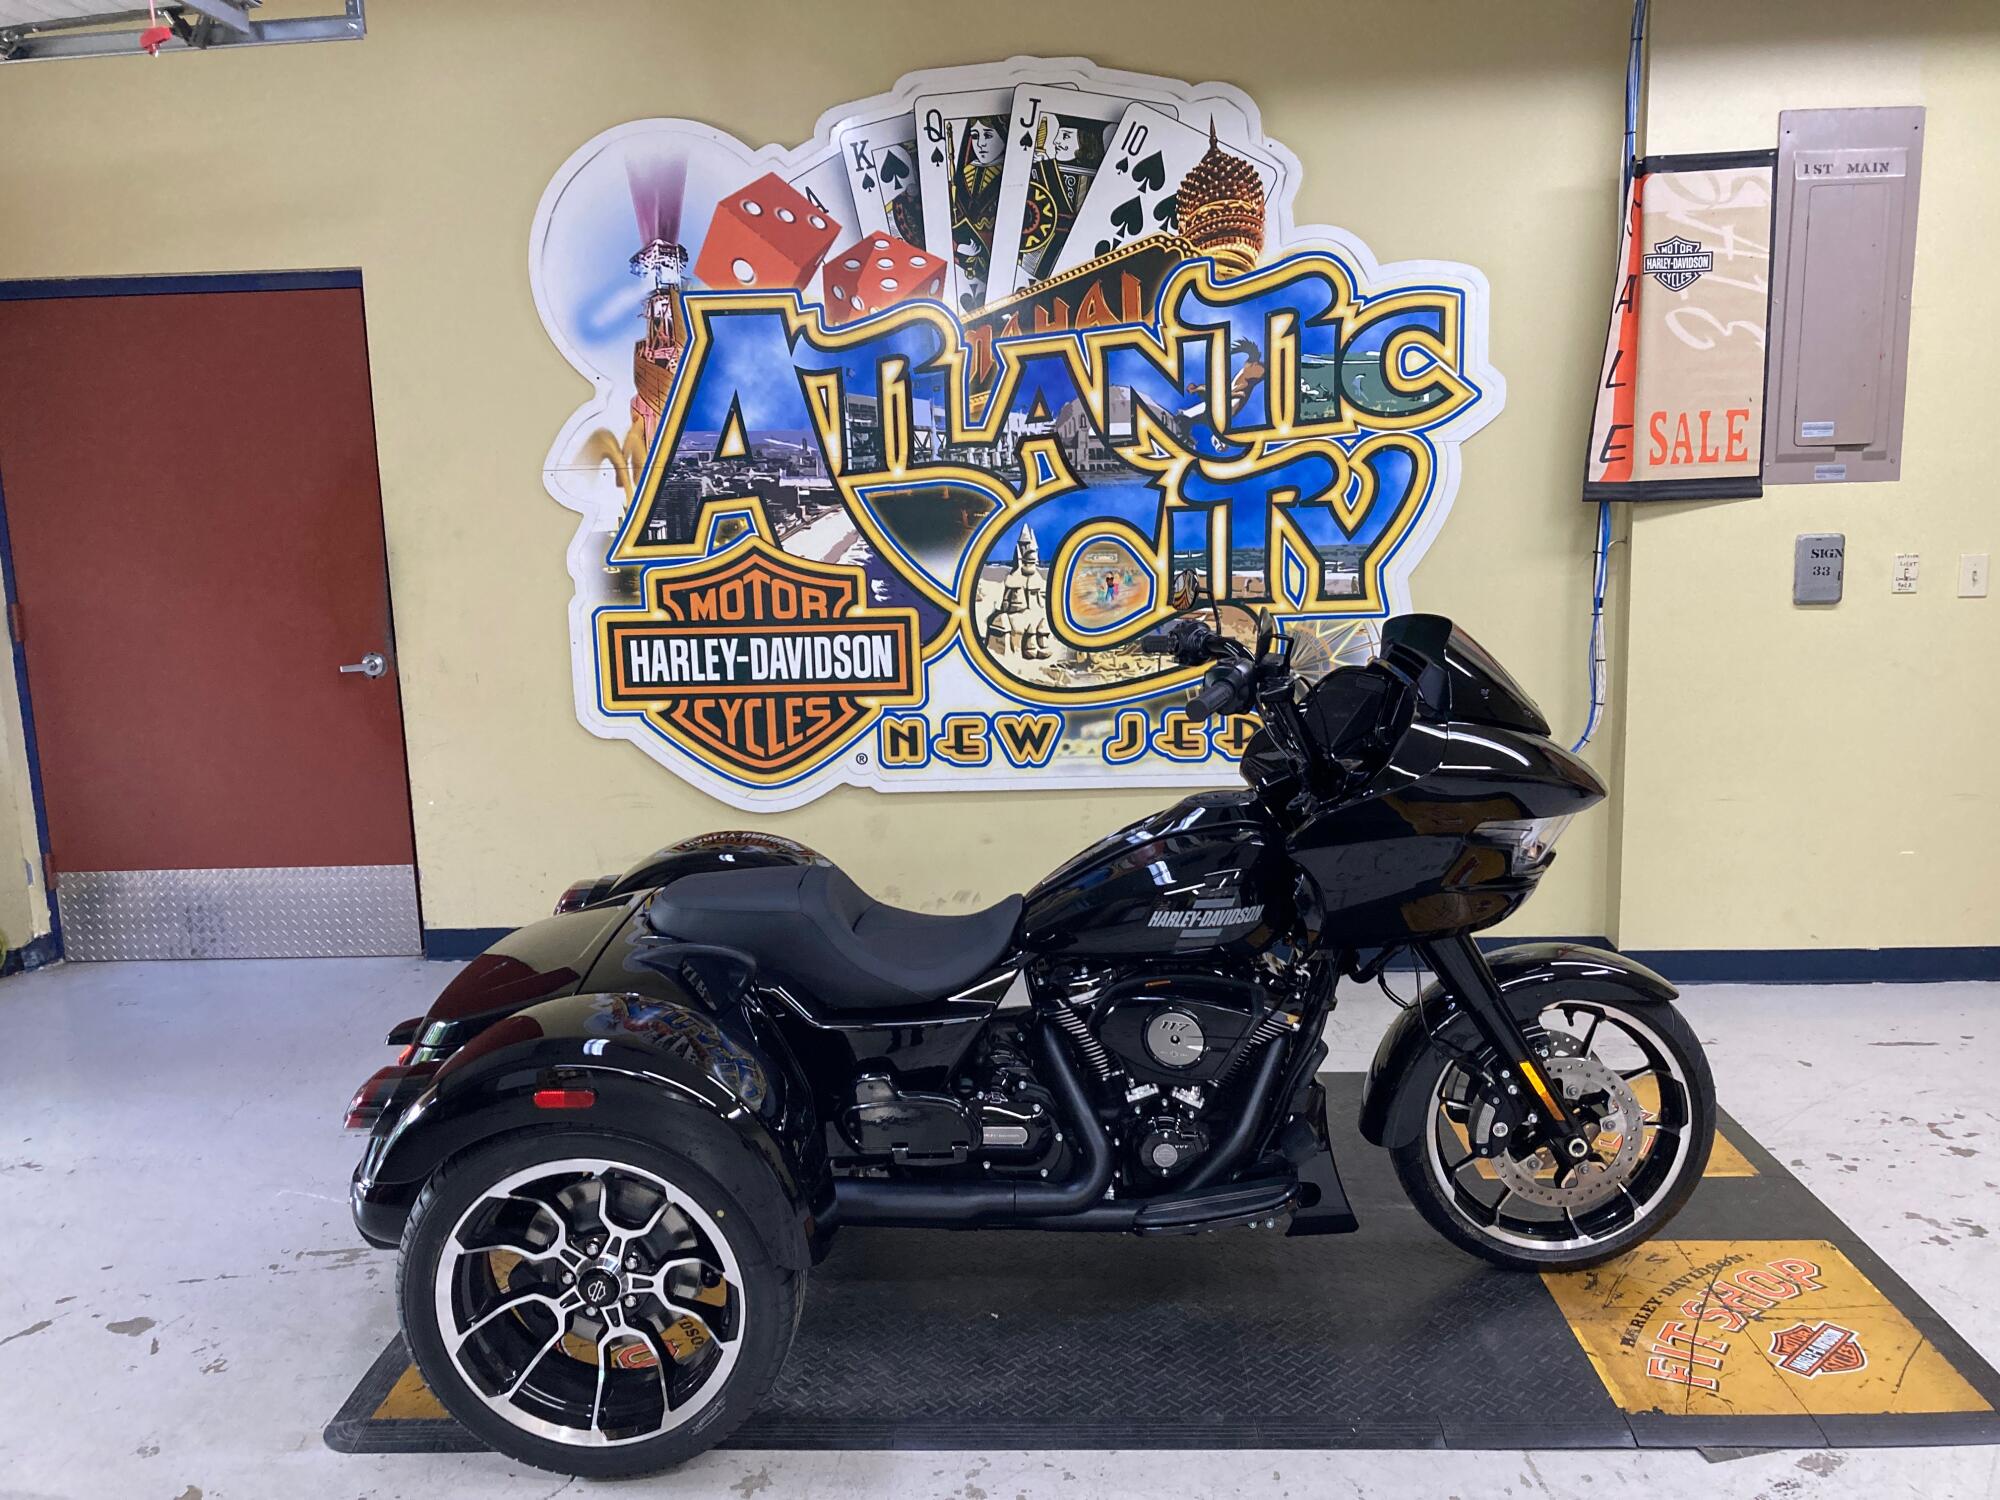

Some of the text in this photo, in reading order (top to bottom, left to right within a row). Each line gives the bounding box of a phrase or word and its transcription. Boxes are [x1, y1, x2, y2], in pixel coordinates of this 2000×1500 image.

[923, 109, 945, 141] Q
[1020, 98, 1041, 129] J
[1121, 120, 1149, 157] 10
[850, 139, 877, 171] K
[1802, 160, 1891, 175] 1ST MAIN
[1646, 256, 1709, 270] HARLEY-DAVIDSON
[1661, 241, 1693, 254] MOTOR
[1661, 272, 1693, 287] CYCLES
[612, 256, 1480, 595] ATLANTIC
[1648, 408, 1750, 466] SALE
[964, 434, 1434, 704] CITY
[1810, 549, 1843, 559] SIGN
[690, 569, 828, 621] MOTOR
[629, 634, 893, 683] HARLEY-DAVIDSON
[694, 697, 832, 757] CYCLES
[885, 717, 1058, 761] NEW
[1148, 904, 1265, 927] HARLEY-DAVIDSON
[1160, 1020, 1191, 1031] 117
[1646, 1257, 1827, 1392] FIT SHOP
